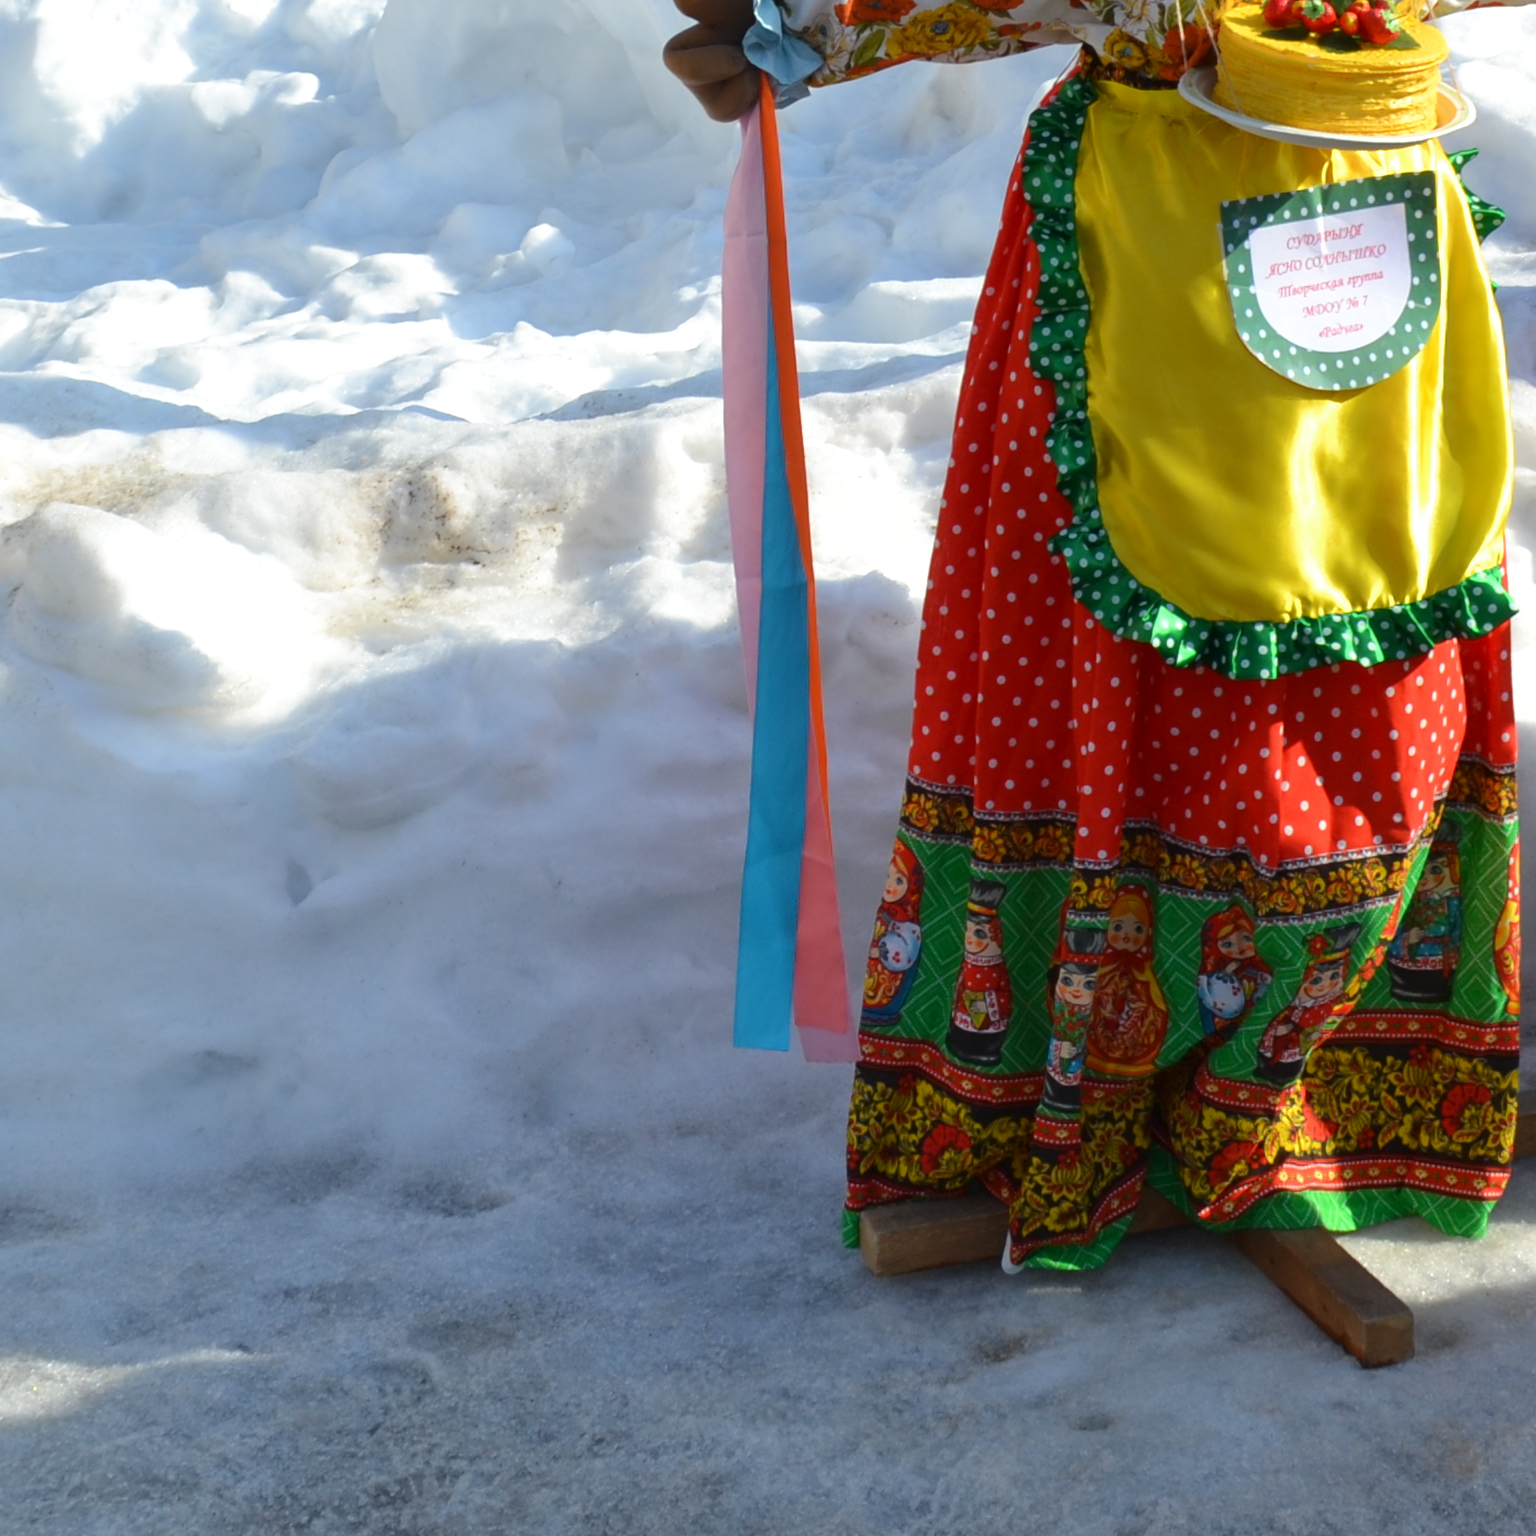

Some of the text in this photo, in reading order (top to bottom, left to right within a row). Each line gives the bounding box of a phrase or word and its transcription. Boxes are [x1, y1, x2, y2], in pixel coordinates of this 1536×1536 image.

[1286, 224, 1363, 250] СУДАРЫНЯ
[1265, 244, 1386, 279] ЯСНО СОЛНЫШКО
[1278, 270, 1384, 298] Творческая группа
[1303, 299, 1344, 318] МДОУ
[1362, 295, 1368, 306] 7
